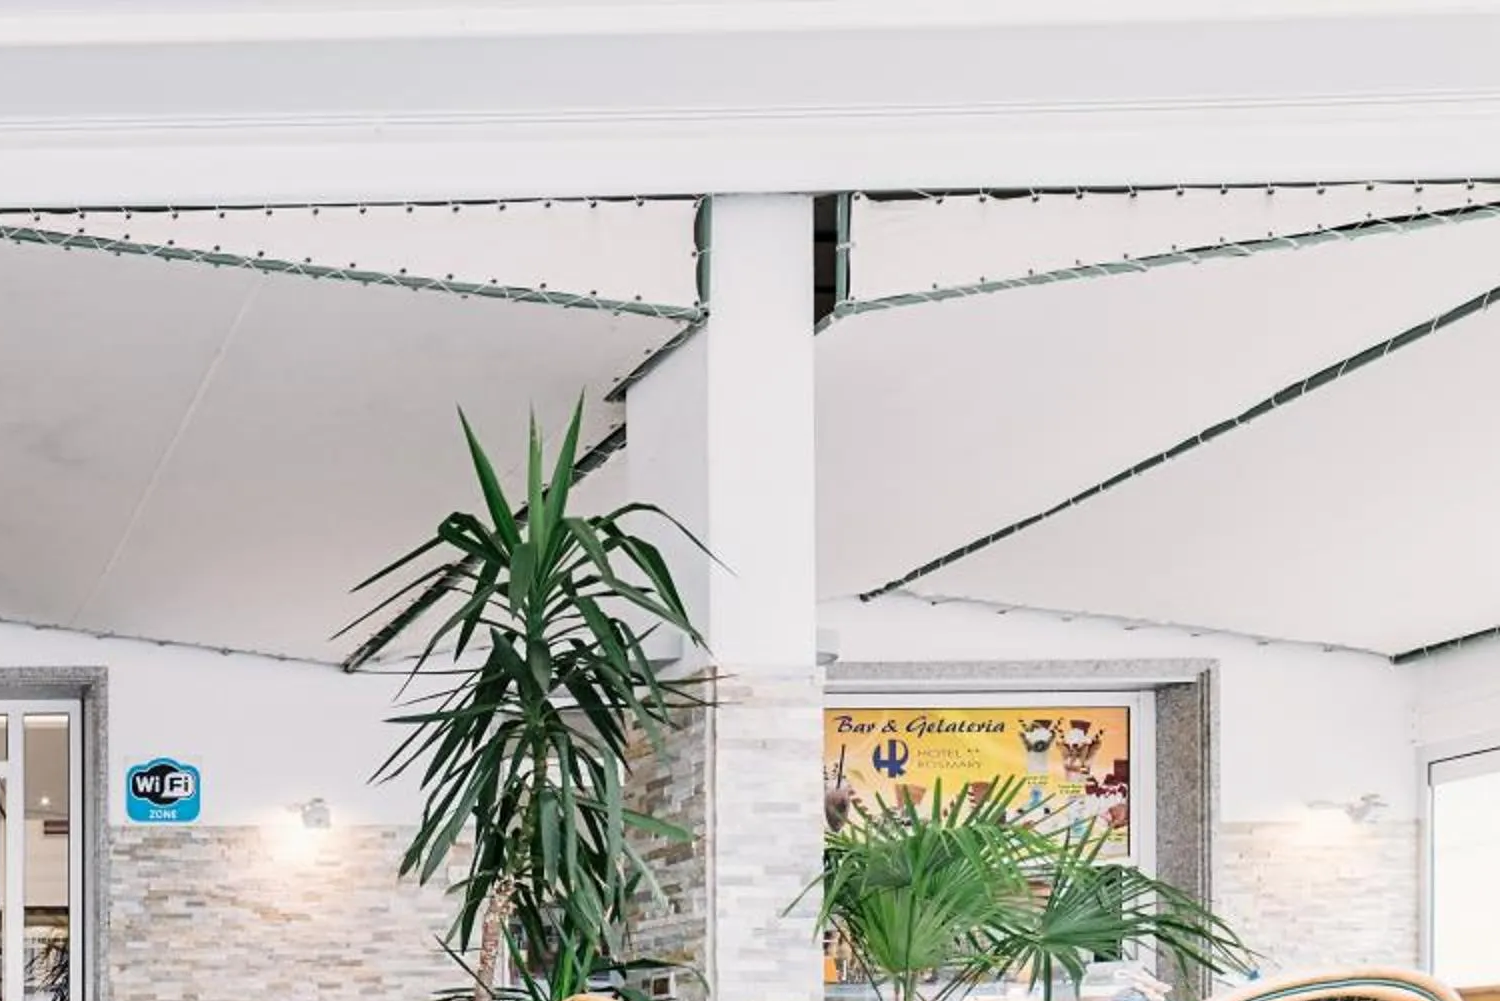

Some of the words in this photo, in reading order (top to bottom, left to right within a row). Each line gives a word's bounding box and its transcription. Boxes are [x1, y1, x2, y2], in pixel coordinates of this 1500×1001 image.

[833, 715, 876, 734] Bar
[881, 719, 898, 733] &
[905, 715, 1006, 738] Gelateria
[917, 748, 961, 758] HOTEL
[148, 809, 178, 819] ZONE
